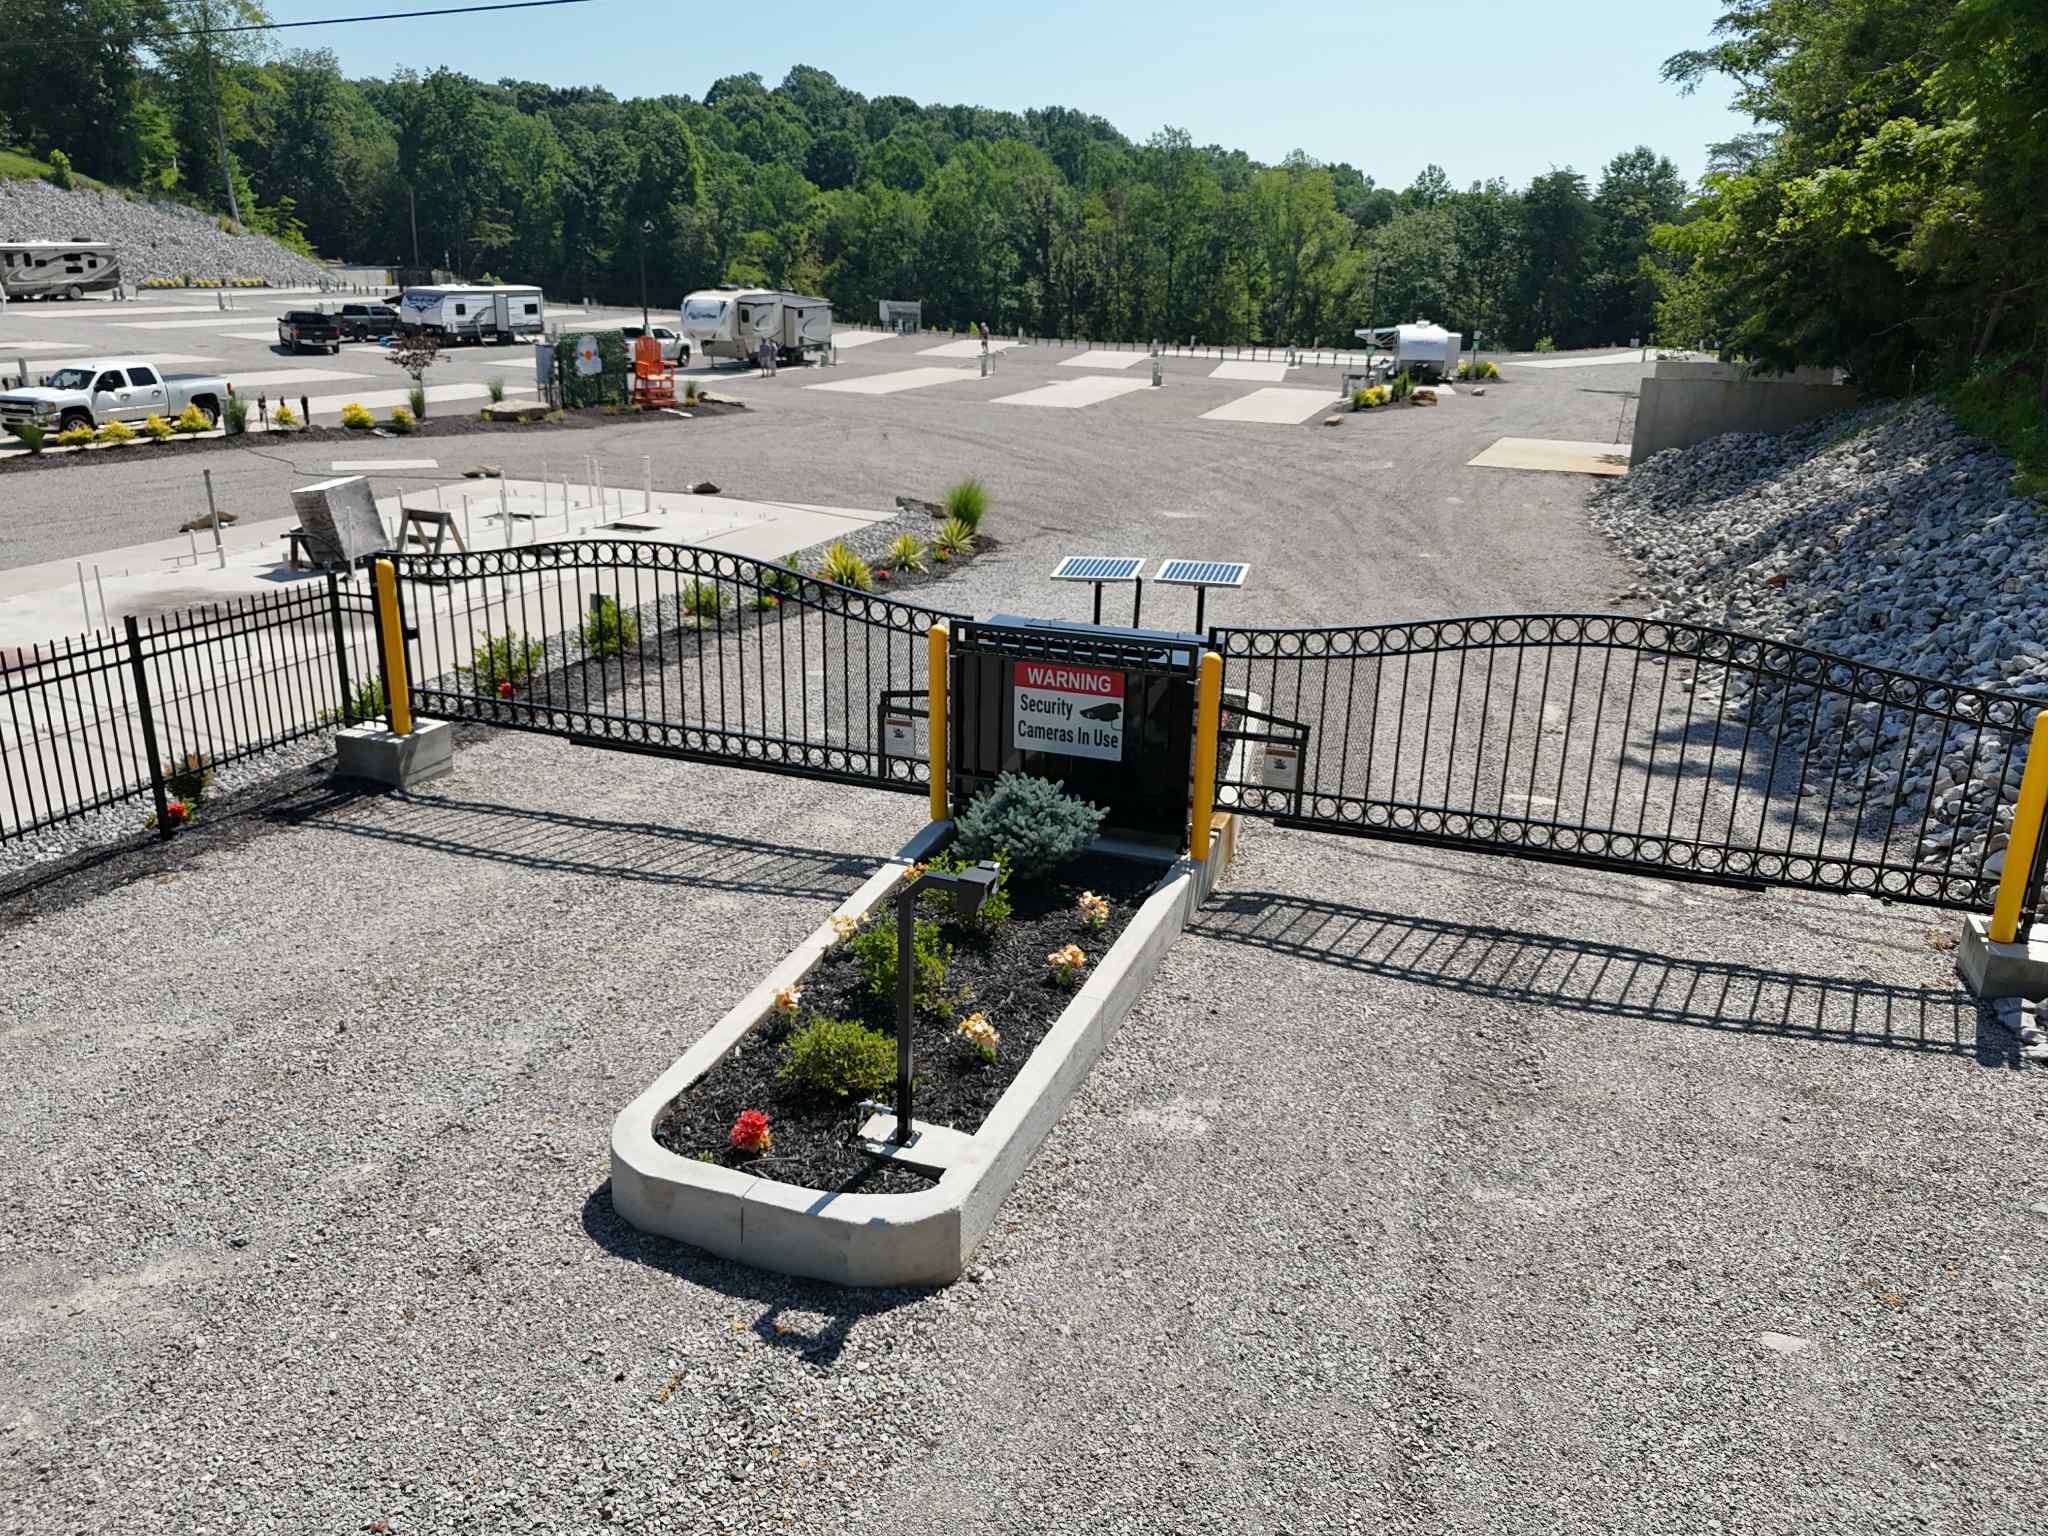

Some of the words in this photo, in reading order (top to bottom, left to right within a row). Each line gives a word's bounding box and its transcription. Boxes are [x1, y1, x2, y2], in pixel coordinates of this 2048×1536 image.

[1027, 667, 1112, 693] WARNING
[1020, 694, 1073, 721] Security
[1018, 720, 1074, 743] Cameras
[1078, 727, 1090, 745] In
[1094, 728, 1119, 748] Use
